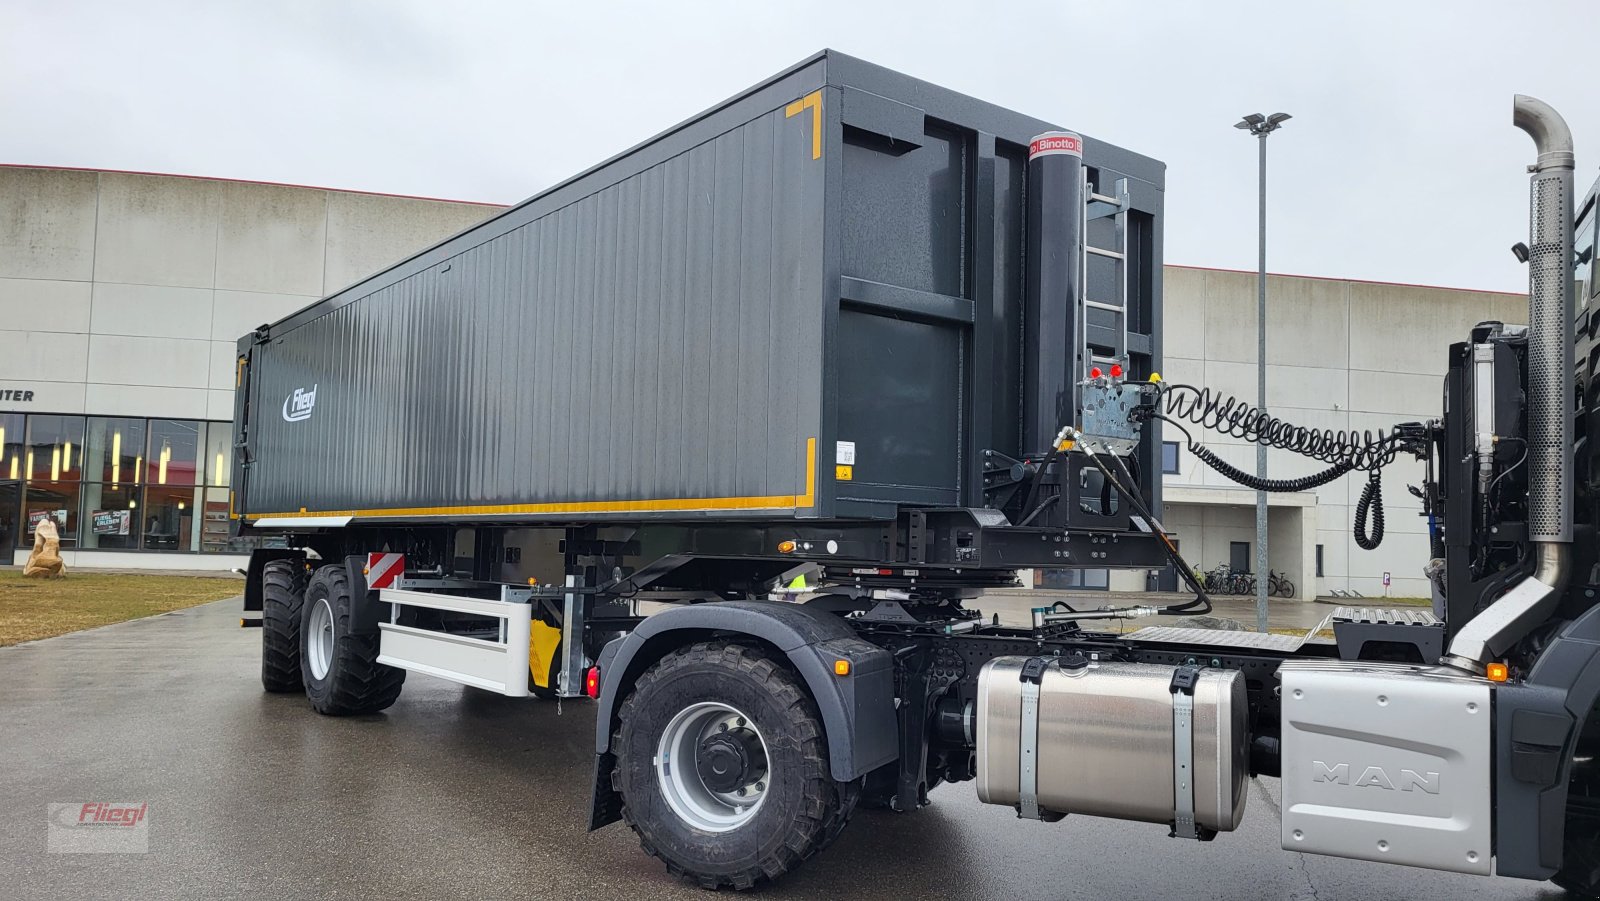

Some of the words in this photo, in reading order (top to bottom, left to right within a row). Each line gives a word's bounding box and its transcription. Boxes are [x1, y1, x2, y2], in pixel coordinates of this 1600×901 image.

[1039, 139, 1074, 150] Binotto
[291, 383, 317, 414] Fliegl
[1312, 760, 1440, 795] MAN
